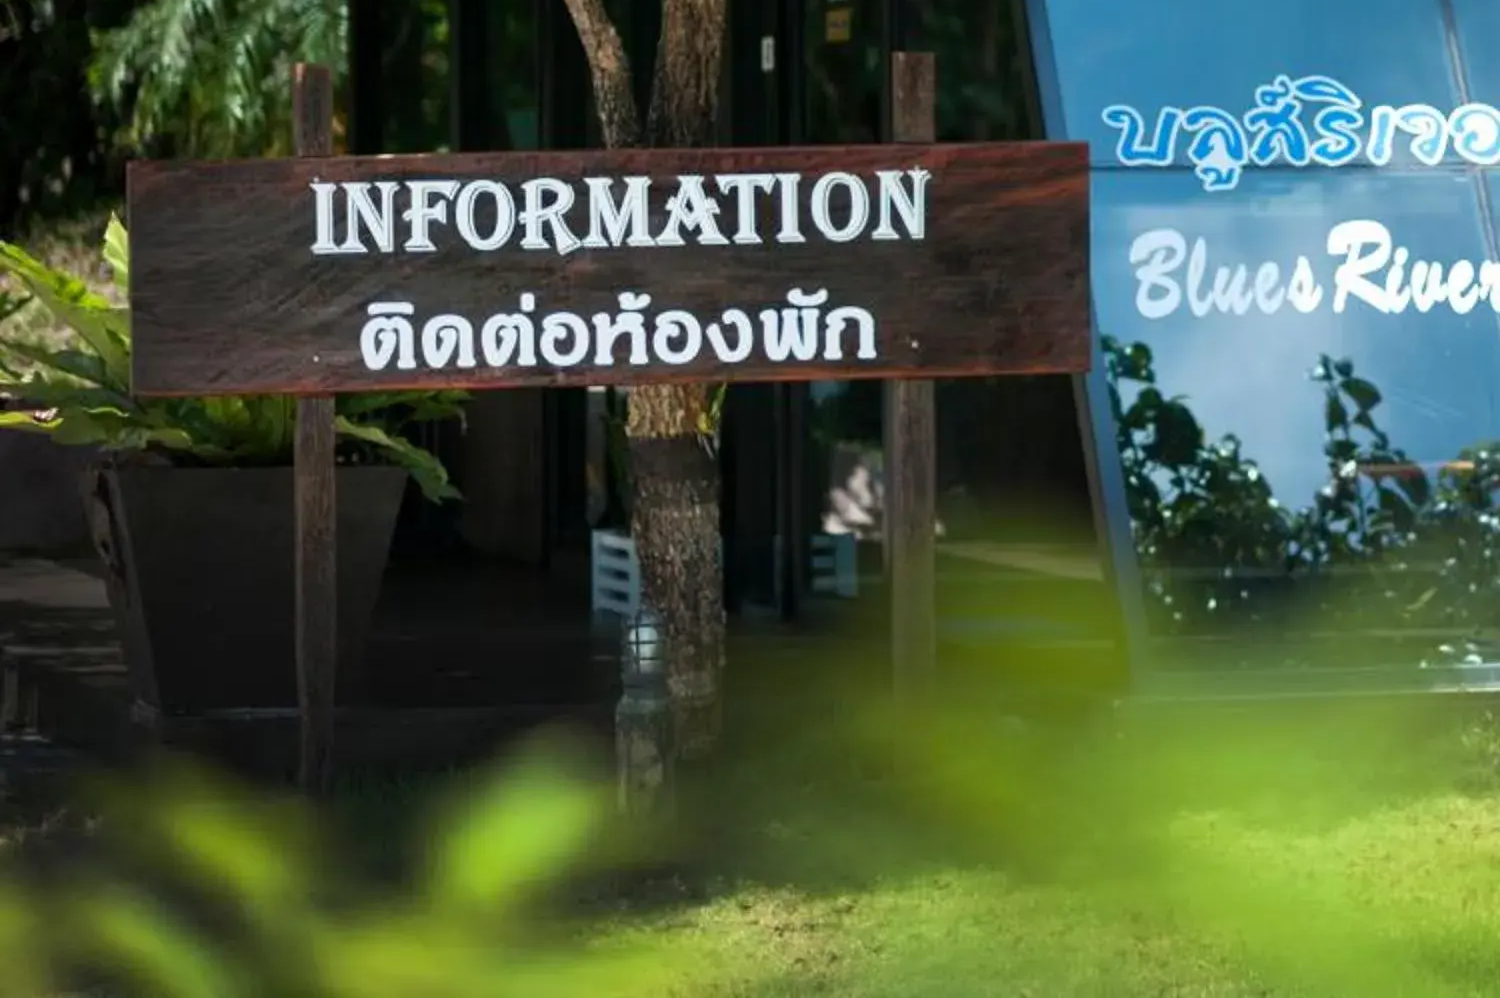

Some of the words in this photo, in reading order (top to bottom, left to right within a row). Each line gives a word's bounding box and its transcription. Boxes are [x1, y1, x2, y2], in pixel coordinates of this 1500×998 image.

[309, 166, 932, 255] INFORMATION
[1129, 228, 1324, 319] Blues
[359, 287, 877, 370] ติดต่อห้องพัก
